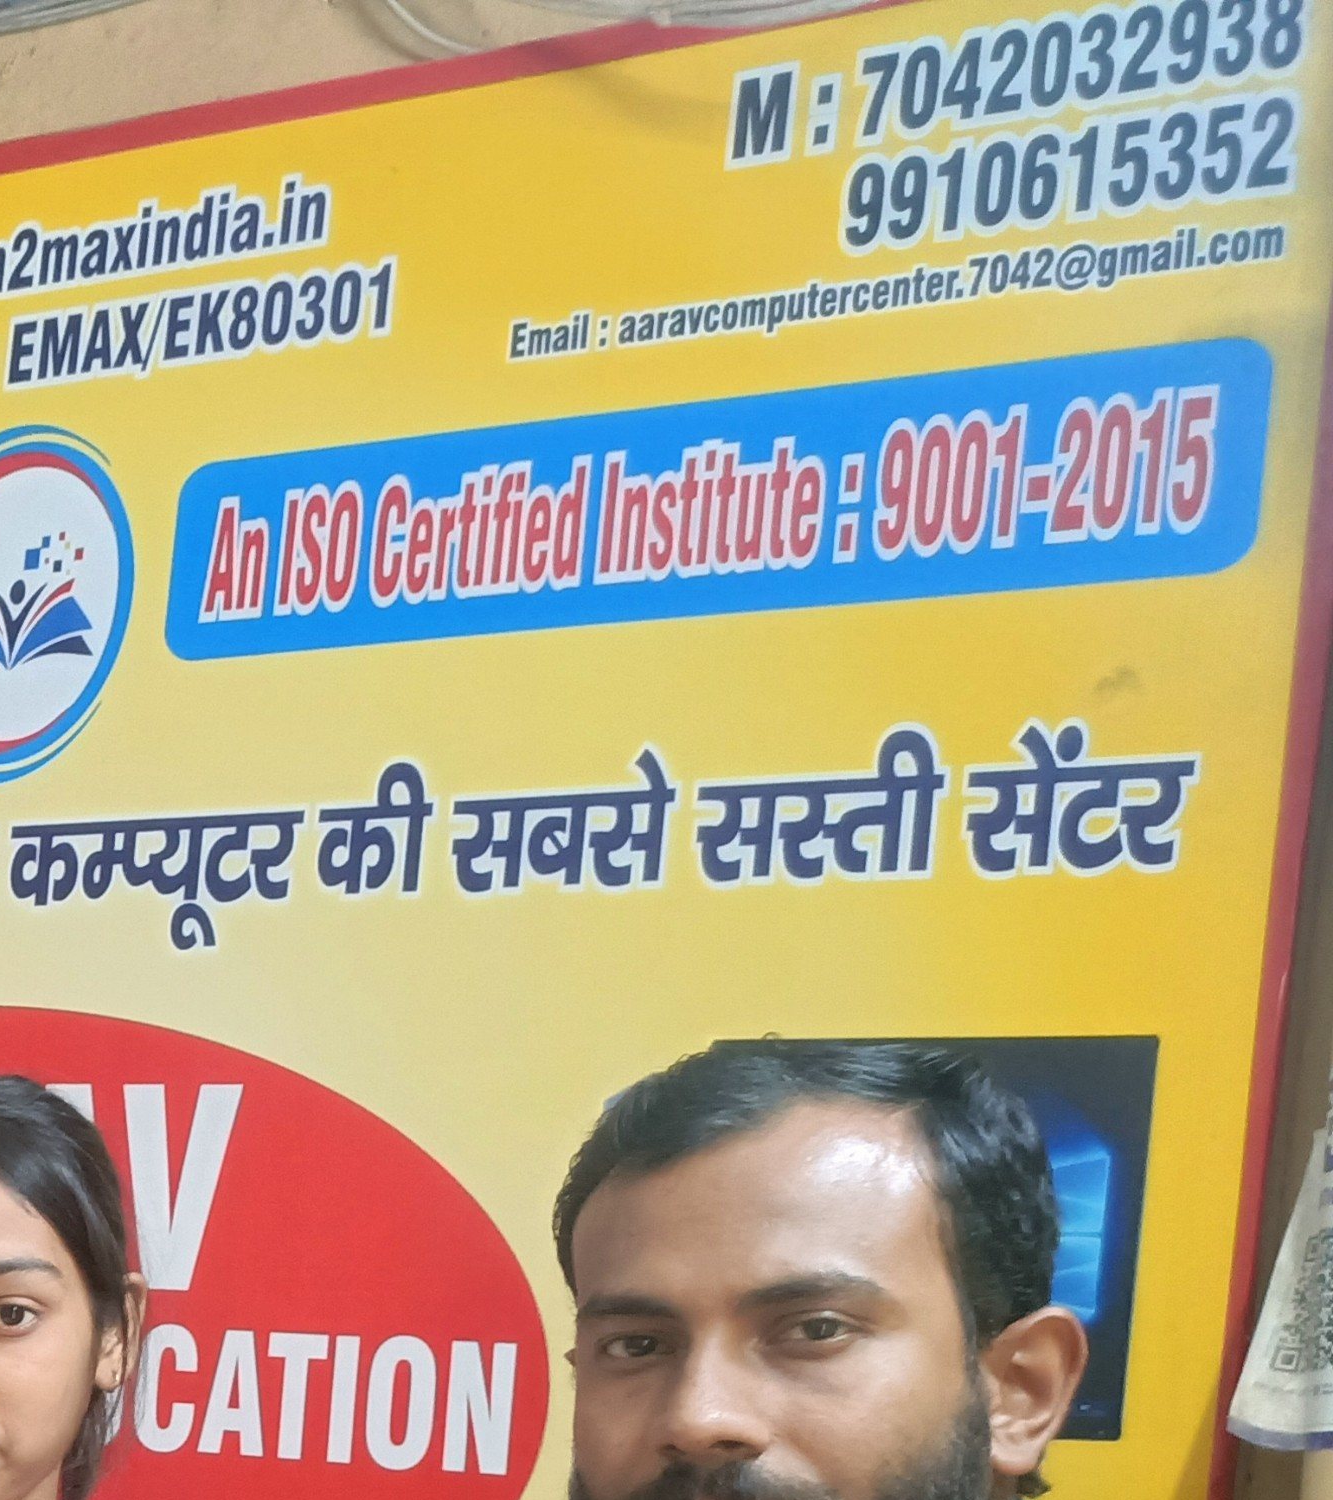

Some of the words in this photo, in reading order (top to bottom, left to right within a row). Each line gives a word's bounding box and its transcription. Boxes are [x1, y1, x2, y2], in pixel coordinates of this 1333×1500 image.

[734, 70, 794, 161] M
[813, 82, 834, 145] :
[860, 0, 1302, 138] 7042032938
[844, 97, 1293, 247] 9910615352
[7, 262, 396, 386] EMAX/EK80301
[509, 315, 589, 359] Email
[598, 320, 609, 348] :
[618, 223, 1285, 348] aaravcomputercenter.7042@gmail.com
[202, 498, 269, 619] An
[277, 486, 360, 616] ISO
[373, 458, 586, 600] Certified
[599, 440, 823, 576] Institute
[836, 456, 862, 558] :
[875, 393, 1216, 555] 9001-2015
[8, 807, 305, 951] कम्प्यूटर
[316, 761, 433, 895] की
[451, 748, 677, 891] सबसे
[695, 730, 946, 883] सस्ती
[963, 725, 1198, 874] सेंटर
[118, 1322, 519, 1475] CATION
